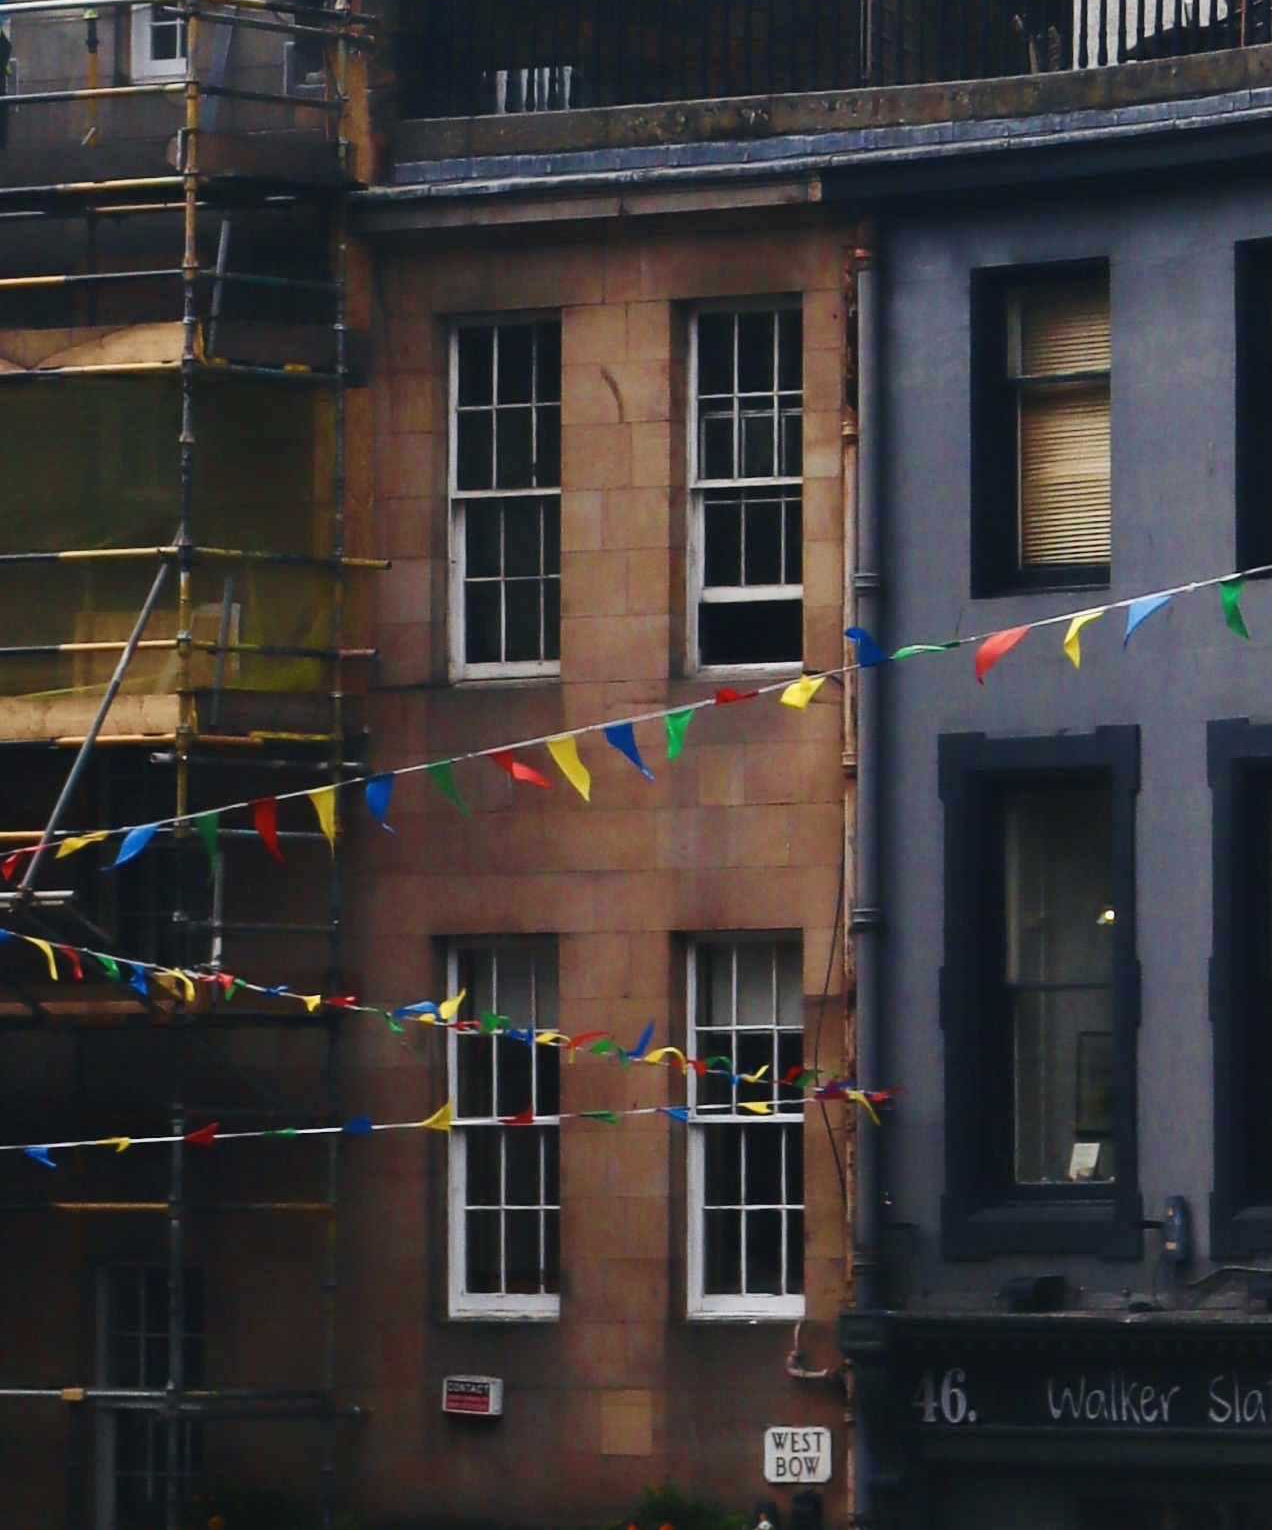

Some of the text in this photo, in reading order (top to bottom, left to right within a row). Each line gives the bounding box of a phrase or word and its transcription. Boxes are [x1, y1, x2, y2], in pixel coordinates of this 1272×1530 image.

[911, 1366, 979, 1424] 46.
[1046, 1368, 1182, 1424] Walker
[771, 1432, 824, 1453] WEST
[776, 1456, 820, 1477] BOW
